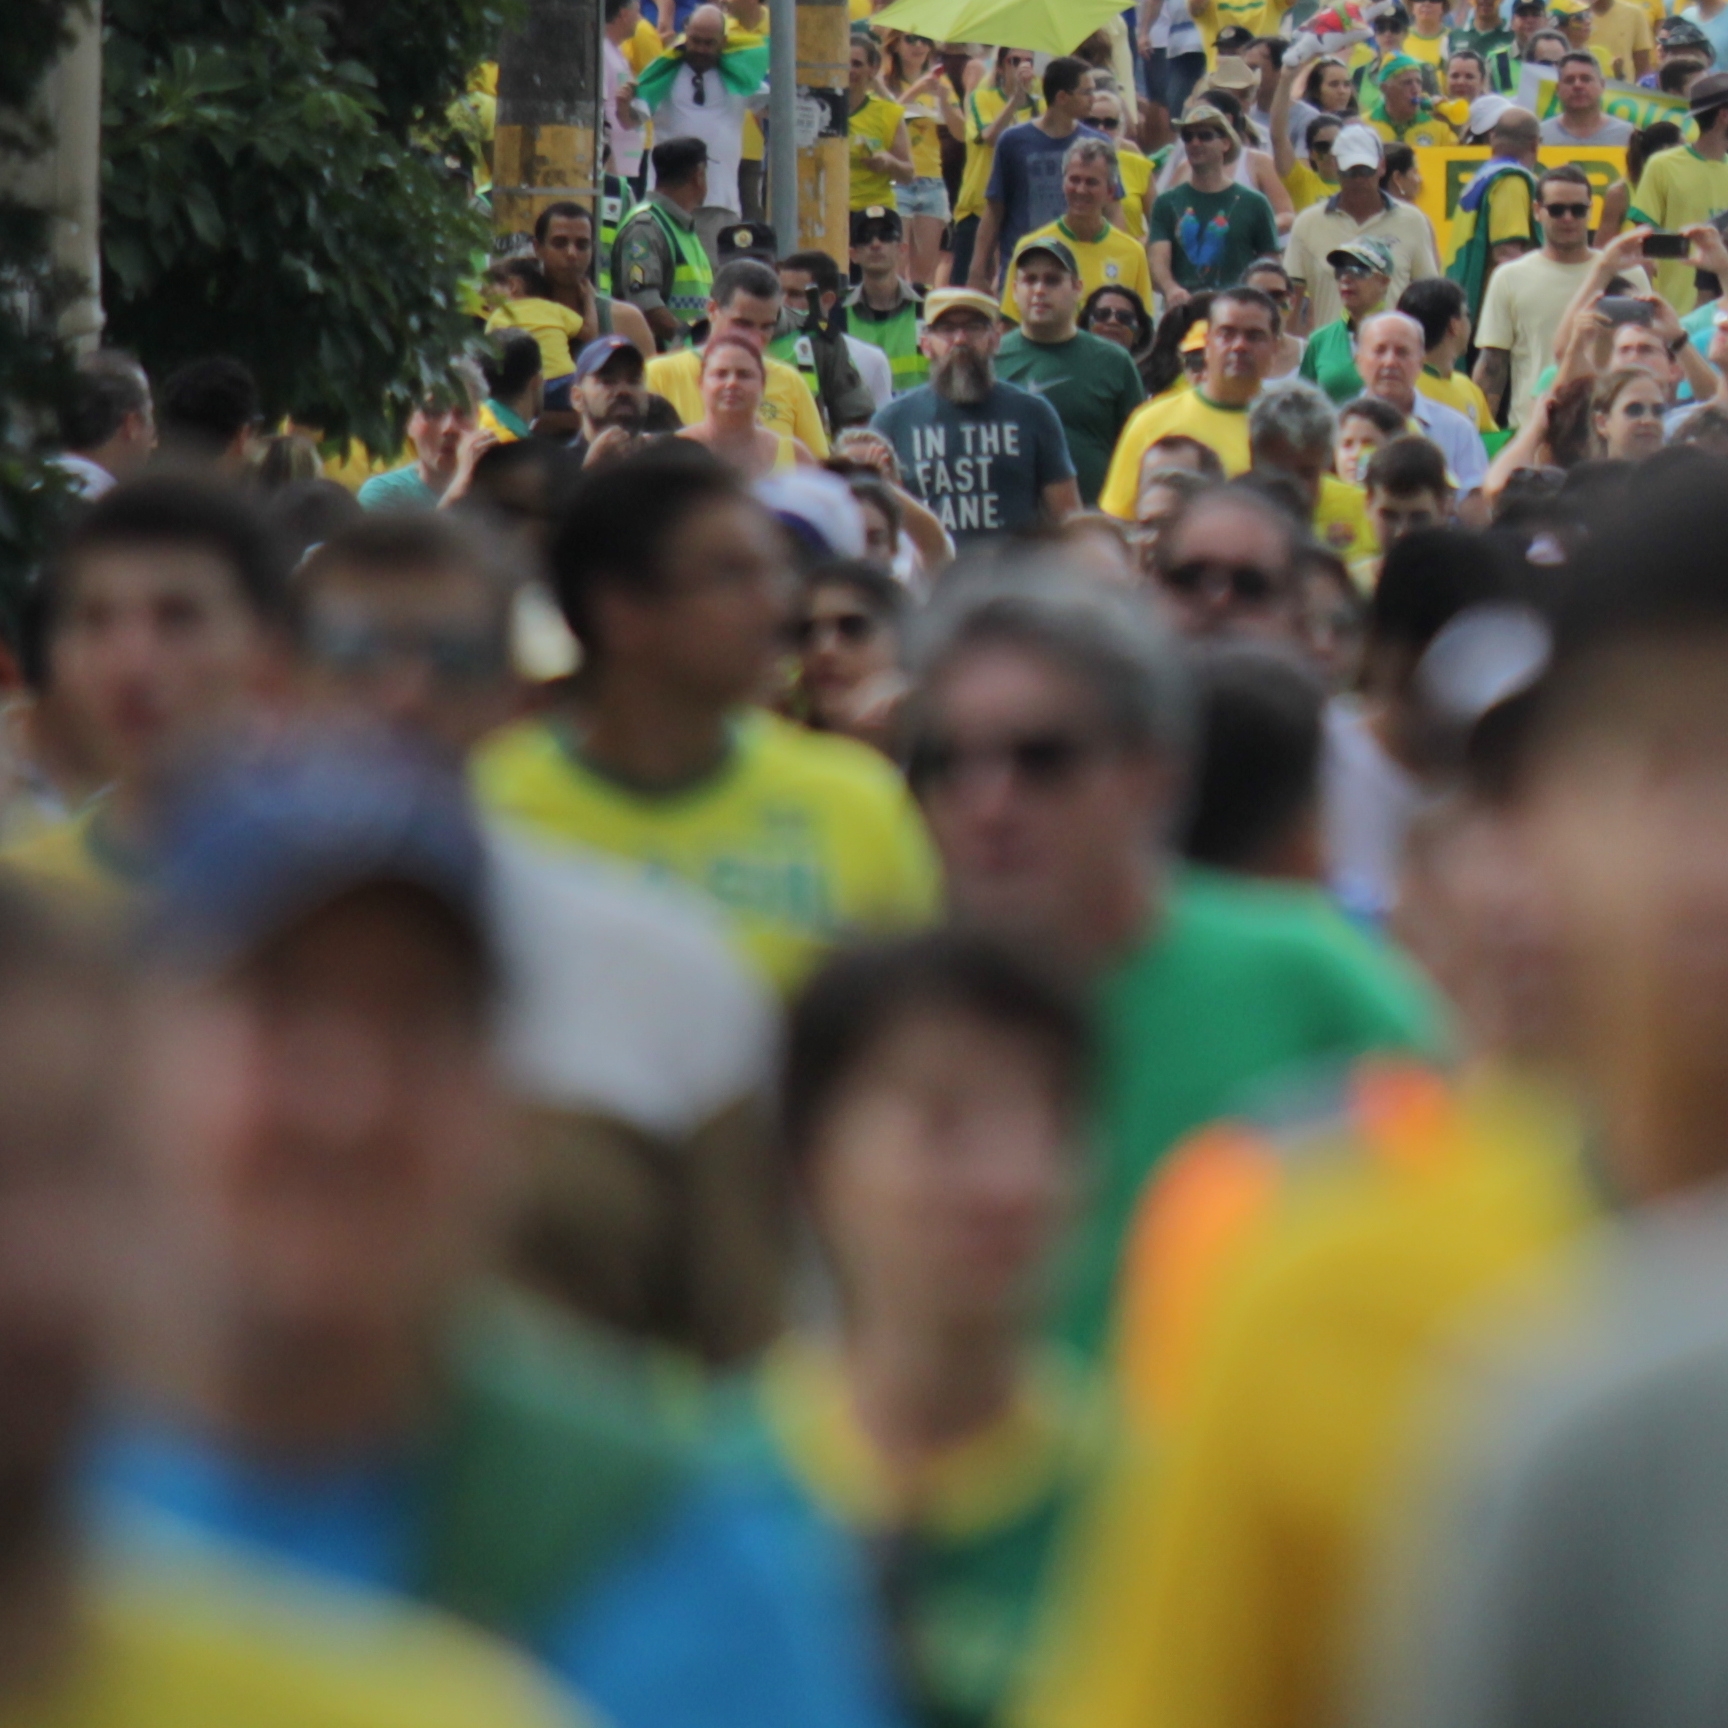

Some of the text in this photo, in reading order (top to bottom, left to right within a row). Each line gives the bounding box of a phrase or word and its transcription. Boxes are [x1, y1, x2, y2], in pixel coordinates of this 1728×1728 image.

[913, 424, 1020, 460] IN THE
[914, 457, 992, 495] FAST
